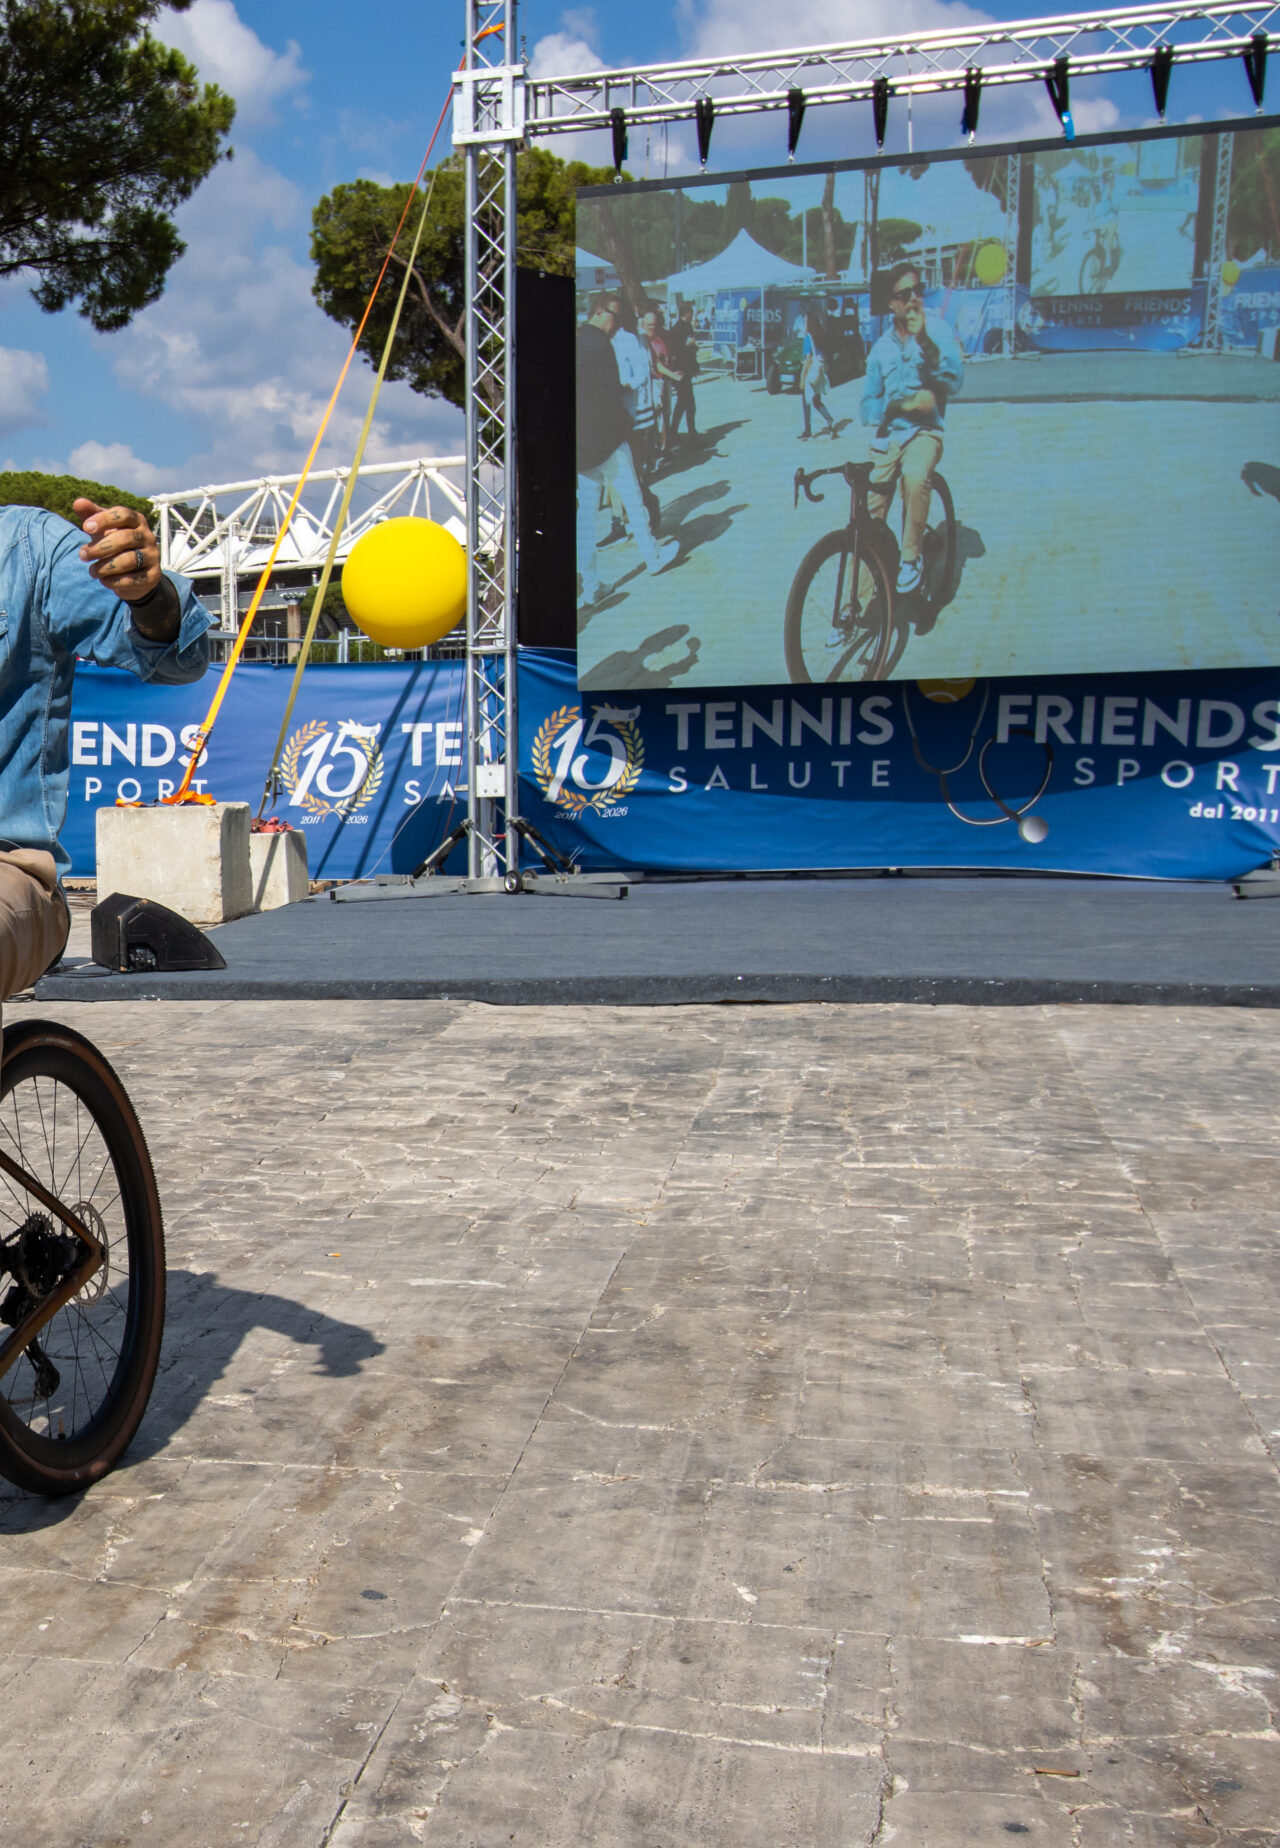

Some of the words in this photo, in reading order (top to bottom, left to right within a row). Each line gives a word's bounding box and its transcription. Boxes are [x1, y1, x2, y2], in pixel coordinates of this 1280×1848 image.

[1124, 297, 1192, 314] FRIENDS
[665, 696, 895, 751] TENNIS
[996, 695, 1280, 751] FRIENDS
[289, 722, 382, 806] 15
[542, 705, 641, 803] 15
[668, 760, 891, 793] SALUTE
[1073, 757, 1280, 795] SPORT
[66, 777, 208, 803] PORT
[300, 815, 320, 825] 2011
[345, 815, 369, 825] 2026
[602, 806, 629, 818] 2026
[1189, 803, 1224, 819] dal
[1230, 805, 1279, 823] 2011
